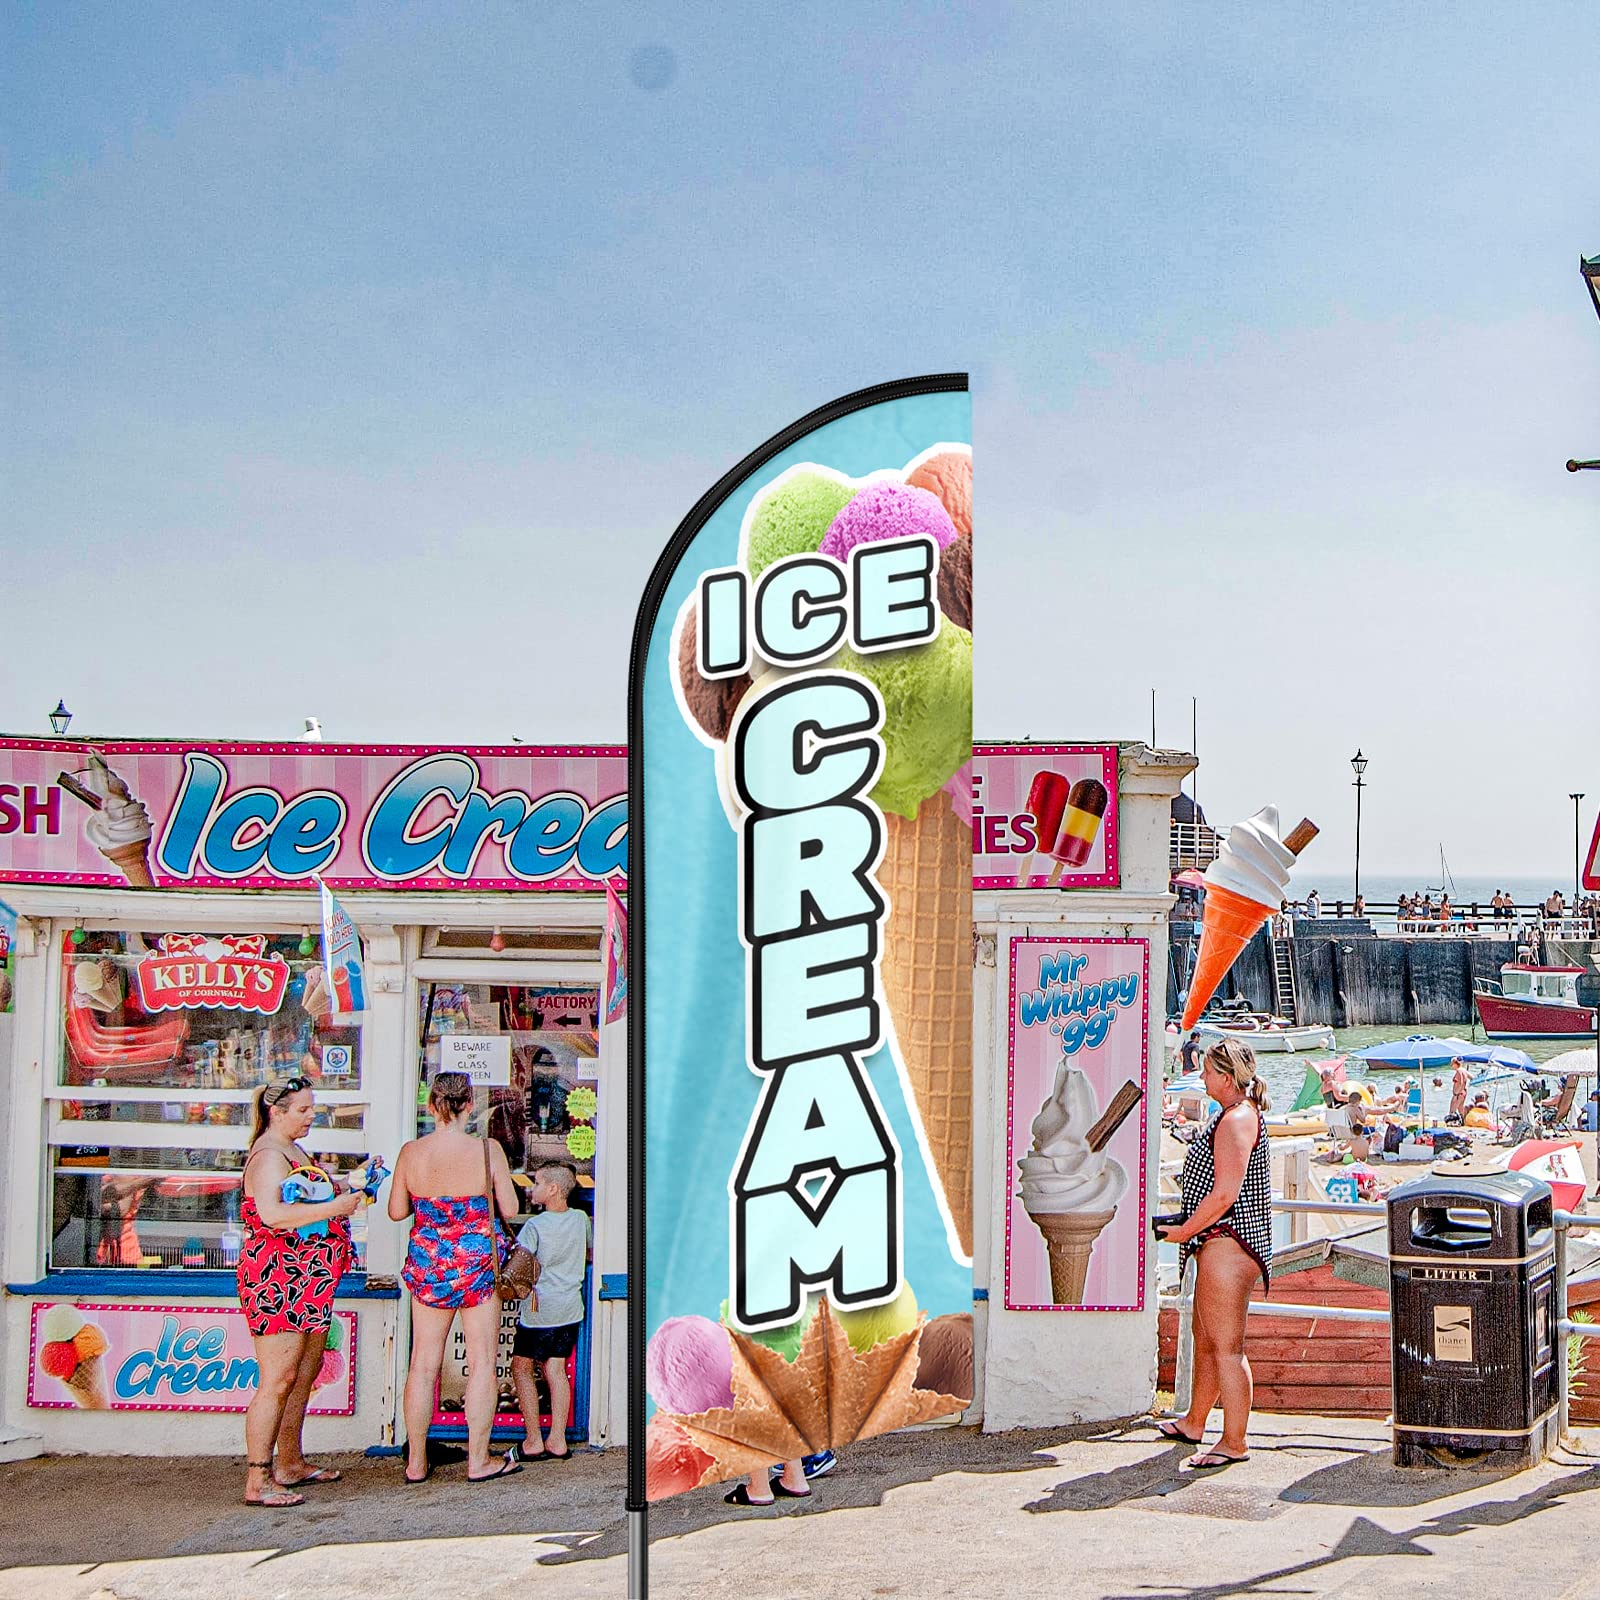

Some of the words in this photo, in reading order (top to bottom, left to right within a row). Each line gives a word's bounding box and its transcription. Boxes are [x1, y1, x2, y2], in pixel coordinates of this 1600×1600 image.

[701, 538, 936, 674] ICE
[157, 752, 348, 880] Ice
[362, 752, 628, 881] Crea
[152, 963, 275, 993] KELLY'S
[1039, 951, 1088, 990] Mr
[178, 990, 192, 998] OF
[194, 990, 246, 999] CORNWALL
[537, 996, 597, 1010] FACTORY
[733, 674, 897, 1326] CREAM
[1020, 972, 1140, 1027] Whippy
[453, 1041, 492, 1052] BEWARE
[1424, 1269, 1478, 1281] LITTER
[157, 1315, 227, 1362] Ice
[114, 1349, 260, 1400] Cream
